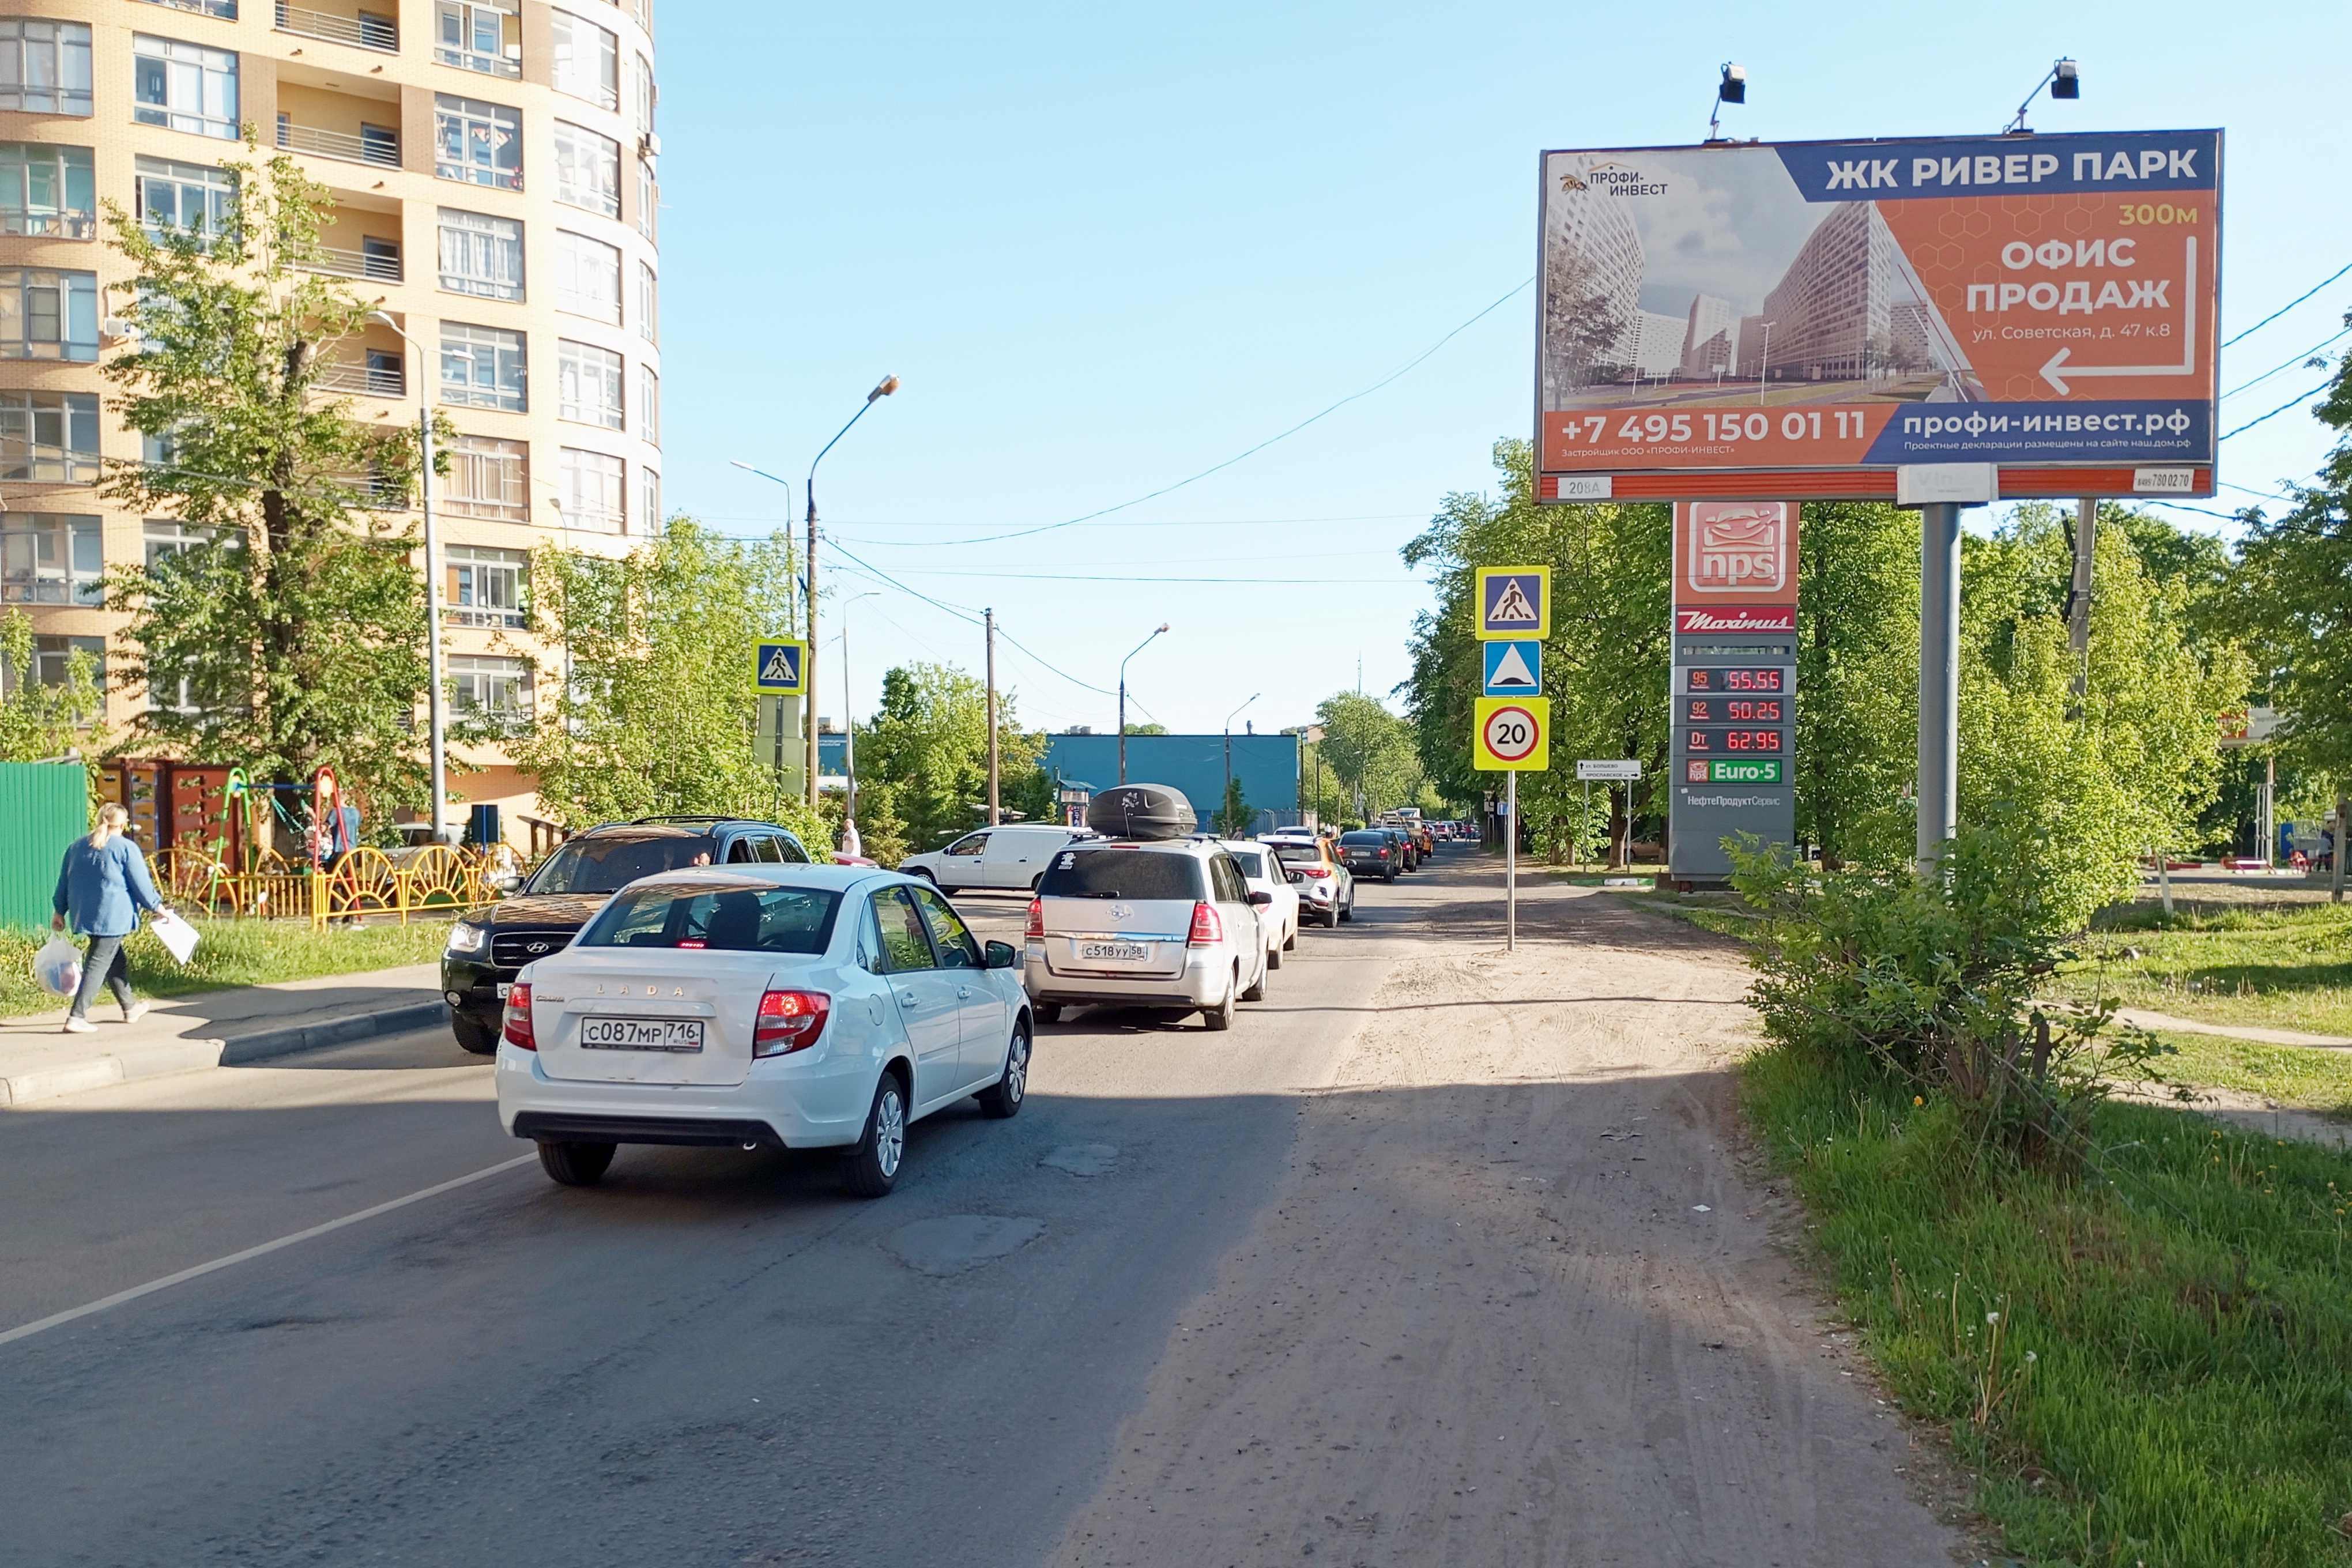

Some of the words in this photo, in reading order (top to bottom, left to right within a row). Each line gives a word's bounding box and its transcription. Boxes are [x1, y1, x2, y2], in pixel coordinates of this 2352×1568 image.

[1590, 172, 1644, 184] ПРОФИ-
[1825, 159, 1899, 190] ЖК
[1912, 154, 2059, 187] РИВЕР
[2072, 149, 2198, 182] ПАРК
[1610, 183, 1668, 196] ИНВЕСТ
[2118, 203, 2198, 225] 300м
[2001, 238, 2136, 270] ОФИС
[1966, 279, 2170, 315] ПРОДАЖ
[1972, 328, 1997, 343] ул.
[2002, 325, 2095, 340] Советская,
[2100, 326, 2115, 340] д.
[2120, 323, 2140, 337] 47
[2146, 323, 2170, 337] к.8
[1562, 416, 1607, 444] +7
[1618, 414, 1693, 443] 495
[1703, 412, 1769, 442] 150
[1781, 412, 1821, 440] 01
[1834, 411, 1864, 439] 11
[1904, 408, 2191, 439] профи-инвест.рф
[1562, 448, 1619, 458] Застройщик
[1621, 447, 1644, 456] ООО
[1904, 441, 1959, 451] Проектные
[1961, 440, 2022, 450] декларации
[2025, 440, 2084, 450] размещены
[2101, 439, 2128, 448] сайте
[1702, 553, 1775, 586] nps
[1677, 611, 1795, 630] Maximus
[1692, 671, 1708, 684] 95
[1729, 671, 1780, 689] 55.55
[1691, 701, 1707, 714] 92
[1728, 702, 1780, 719] 50.25
[1497, 723, 1526, 744] 20
[1728, 732, 1779, 749] 62.95
[1689, 771, 1707, 781] nps
[1687, 796, 1781, 807] НефтеПродуктСервис
[596, 984, 685, 996] LADA
